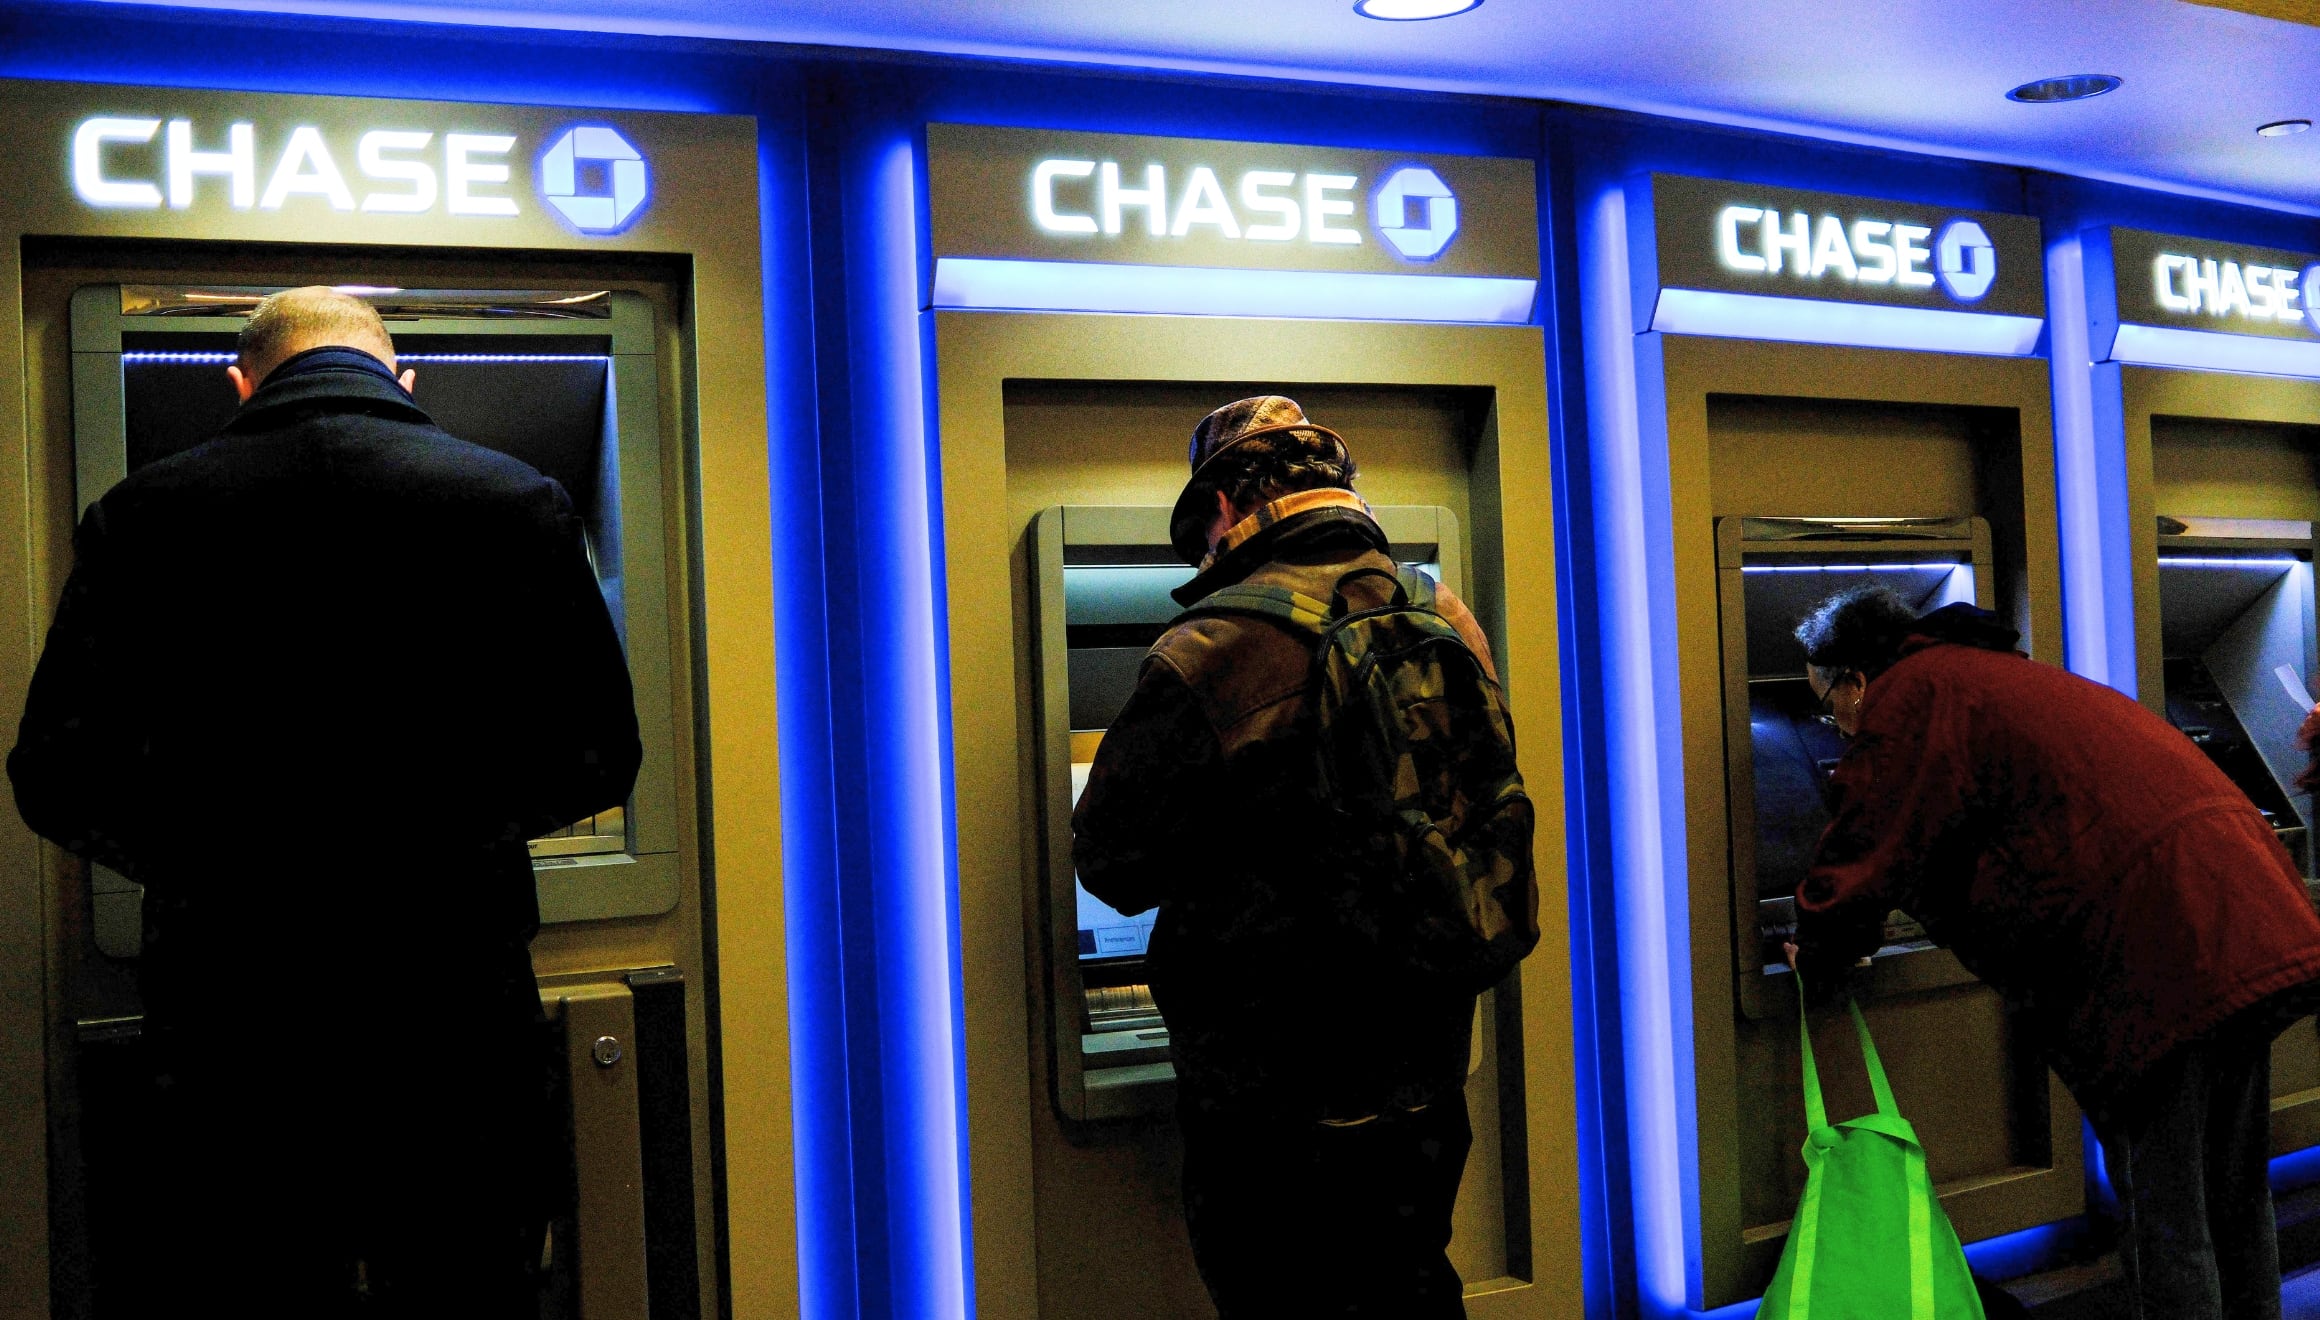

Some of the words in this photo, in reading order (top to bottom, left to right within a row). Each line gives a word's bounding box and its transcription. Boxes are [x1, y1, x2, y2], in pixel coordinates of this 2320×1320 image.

[72, 116, 519, 216] CHASE
[1034, 159, 1362, 244] CHASE
[1719, 206, 1936, 286] CHASE
[2156, 254, 2304, 320] CHASE
